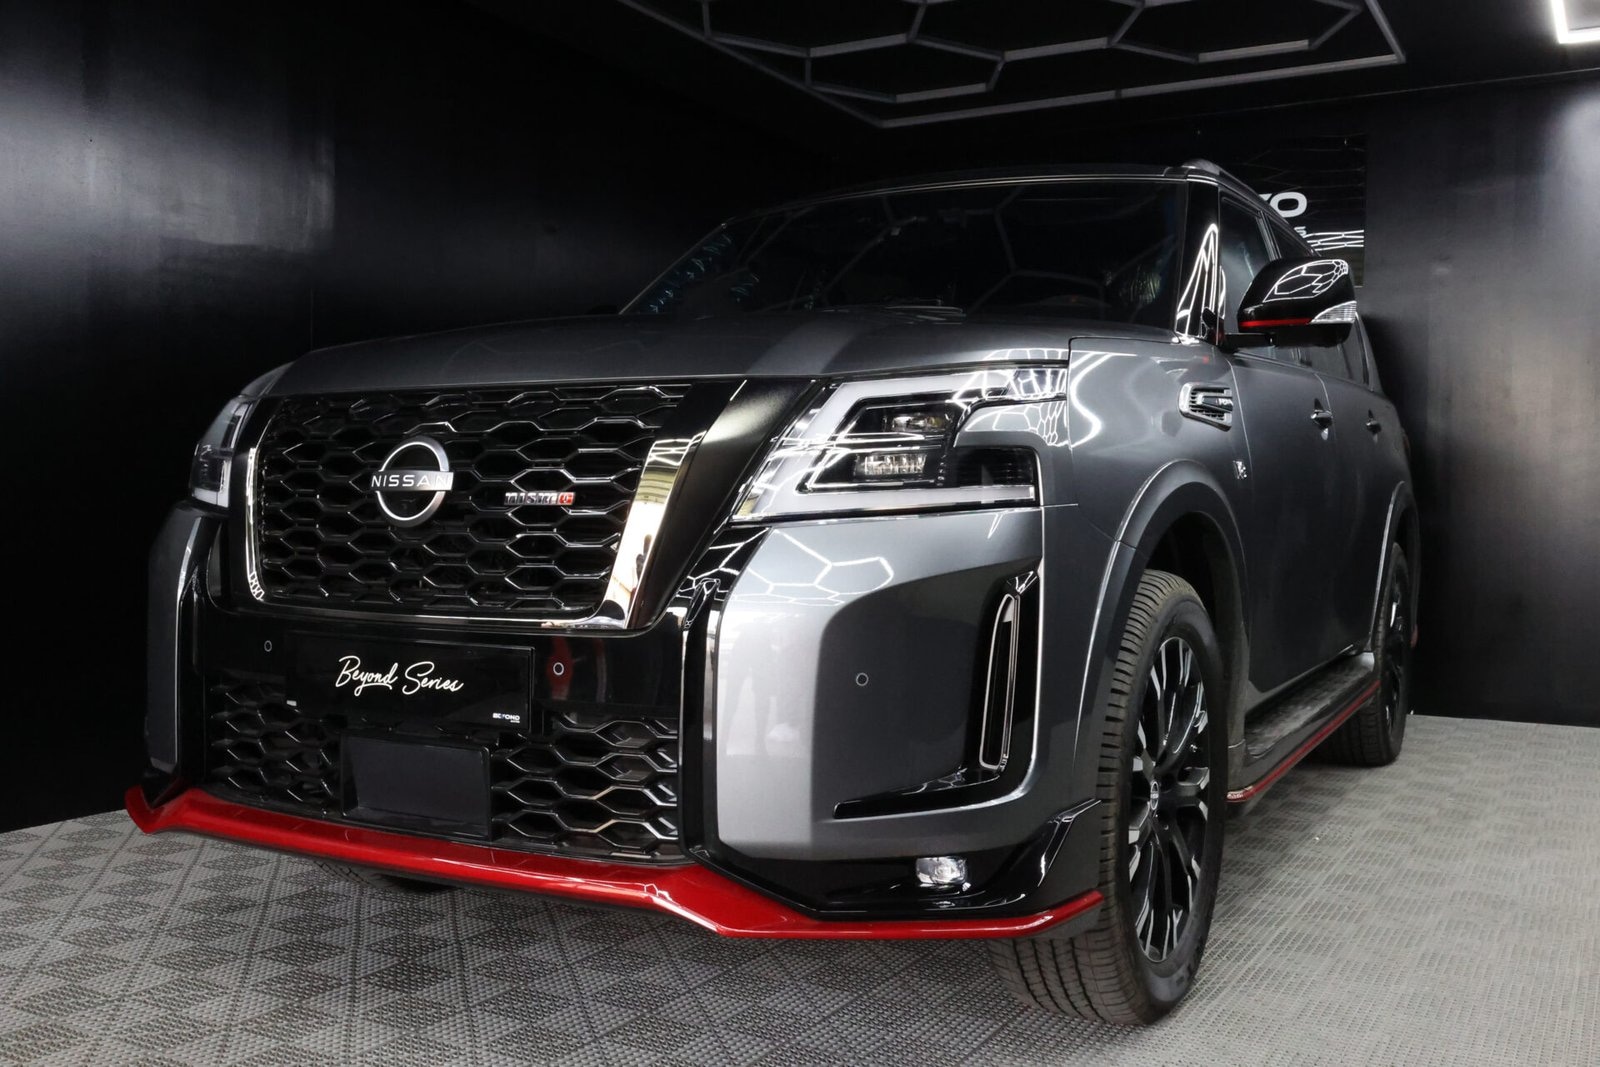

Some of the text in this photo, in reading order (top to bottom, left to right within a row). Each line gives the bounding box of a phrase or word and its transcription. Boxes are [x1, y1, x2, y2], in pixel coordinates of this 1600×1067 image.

[371, 474, 451, 491] NISSAN
[335, 655, 465, 697] Beyond Series
